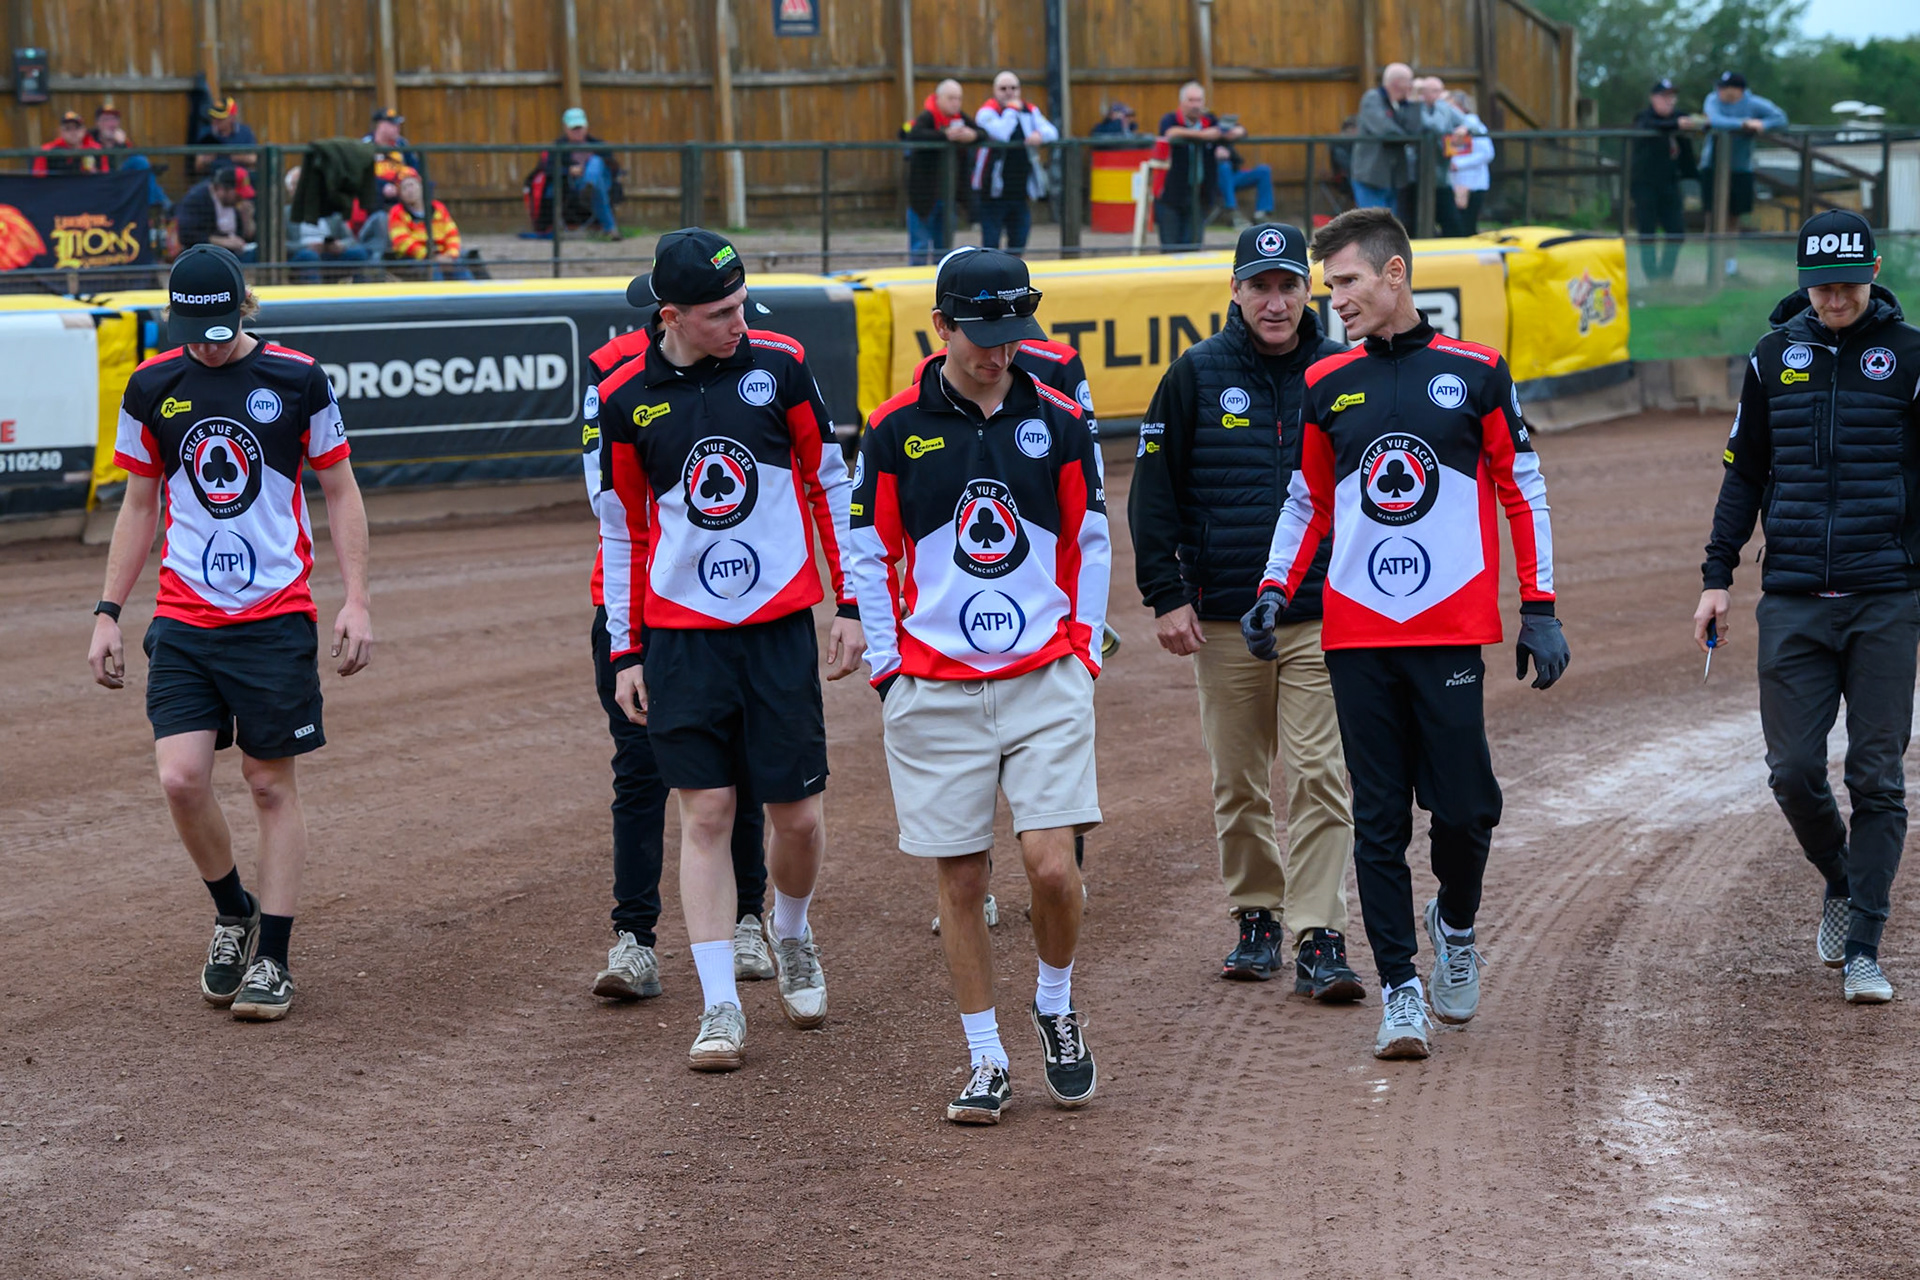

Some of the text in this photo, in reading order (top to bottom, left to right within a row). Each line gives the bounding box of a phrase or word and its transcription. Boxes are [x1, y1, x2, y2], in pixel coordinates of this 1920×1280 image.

[1806, 233, 1864, 255] BOLL
[172, 291, 231, 304] POLCOPPER
[914, 312, 1220, 369] TLIN
[323, 354, 568, 400] DROSCAND
[746, 382, 769, 393] ATPI
[1435, 386, 1459, 396] ATPI
[254, 400, 275, 411] ATPI
[184, 424, 259, 461] BELLE VUE ACES
[1022, 432, 1047, 444] ATPI
[703, 443, 725, 453] VUE
[728, 448, 753, 471] ACES
[1363, 439, 1435, 475] BELLE VUE ACES
[976, 486, 997, 497] VUE
[702, 511, 742, 526] MANCHESTER
[1376, 510, 1418, 521] MANCHESTER
[210, 552, 244, 572] ATPI
[709, 557, 749, 580] ATPI
[968, 562, 1010, 574] MANCHESTER
[1377, 557, 1419, 575] ATPI
[970, 612, 1013, 631] ATPI
